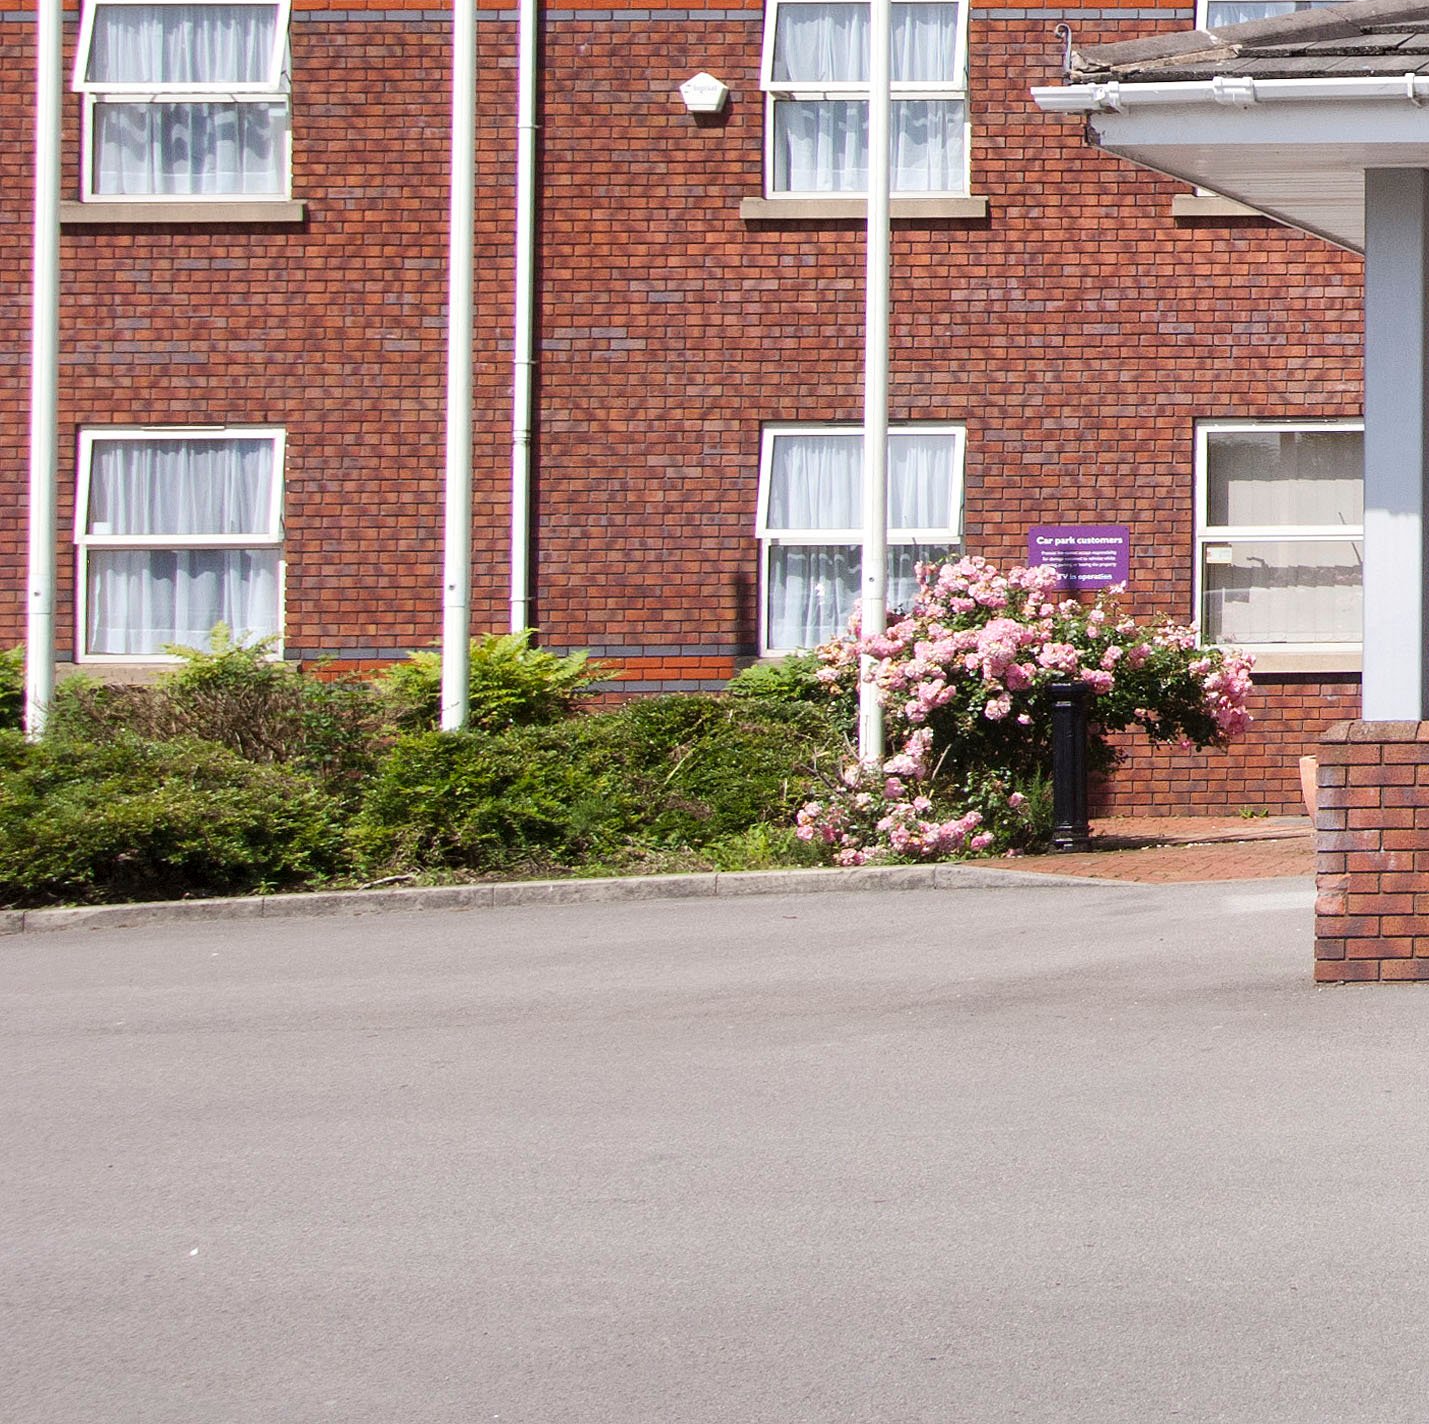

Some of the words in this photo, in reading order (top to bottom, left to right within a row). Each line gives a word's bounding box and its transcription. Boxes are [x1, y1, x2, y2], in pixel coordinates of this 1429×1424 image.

[1036, 536, 1053, 545] Car
[1055, 536, 1075, 546] park
[1077, 537, 1123, 545] customers
